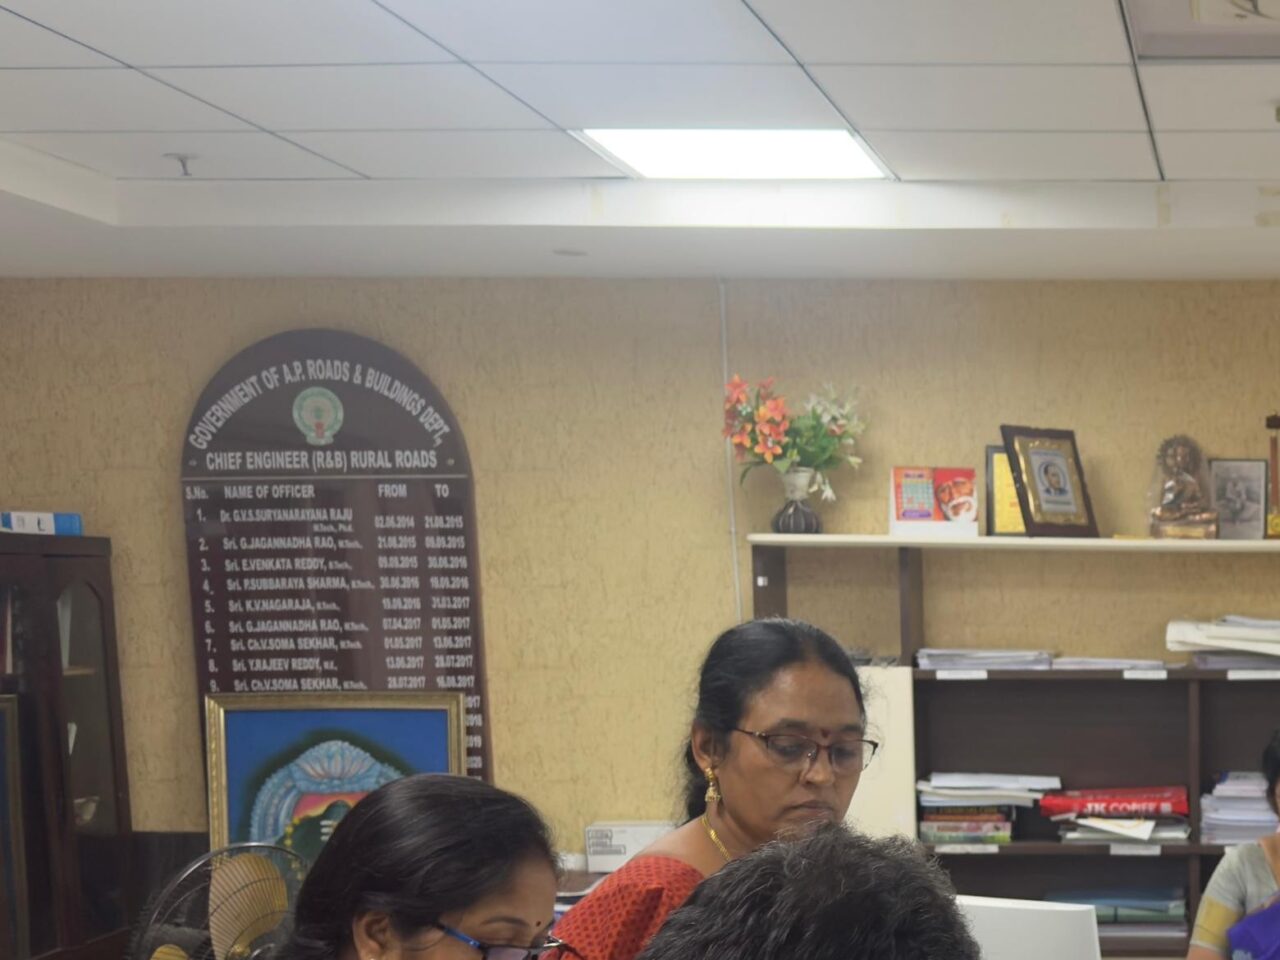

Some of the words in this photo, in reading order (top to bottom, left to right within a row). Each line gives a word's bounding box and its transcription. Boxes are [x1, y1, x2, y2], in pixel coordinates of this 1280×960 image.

[189, 377, 262, 450] GOVERNMENT
[261, 367, 283, 390] OF
[283, 361, 305, 384] A.P.
[306, 359, 350, 382] ROADS
[353, 364, 362, 384] &
[364, 367, 426, 416] BUILDINGS
[206, 452, 243, 470] CHIEF
[246, 452, 309, 469] ENGINEER
[312, 452, 348, 472] (R&B)
[350, 450, 392, 468] RURAL
[395, 450, 438, 468] ROADS
[224, 485, 253, 498] NAME
[255, 485, 270, 498] OF
[272, 484, 316, 498] OFFICER
[378, 484, 408, 497] FROM
[435, 483, 450, 498] TO
[196, 508, 207, 522] 1.
[329, 507, 353, 521] RAJU
[198, 537, 209, 551] 2.
[313, 536, 337, 552] RAO,
[200, 558, 211, 572] 3.
[294, 557, 327, 573] REDDY,
[202, 578, 214, 596] 4.
[306, 576, 350, 592] SHARMA,
[204, 600, 215, 613] 5.
[204, 620, 215, 634] 6.
[319, 618, 343, 634] RAO,
[205, 638, 217, 653] 7.
[297, 637, 338, 653] SEKHAR,
[208, 659, 219, 673] 8.
[291, 658, 322, 674] REDDY,
[209, 680, 221, 693] 9.
[300, 677, 341, 692] SEKHAR,
